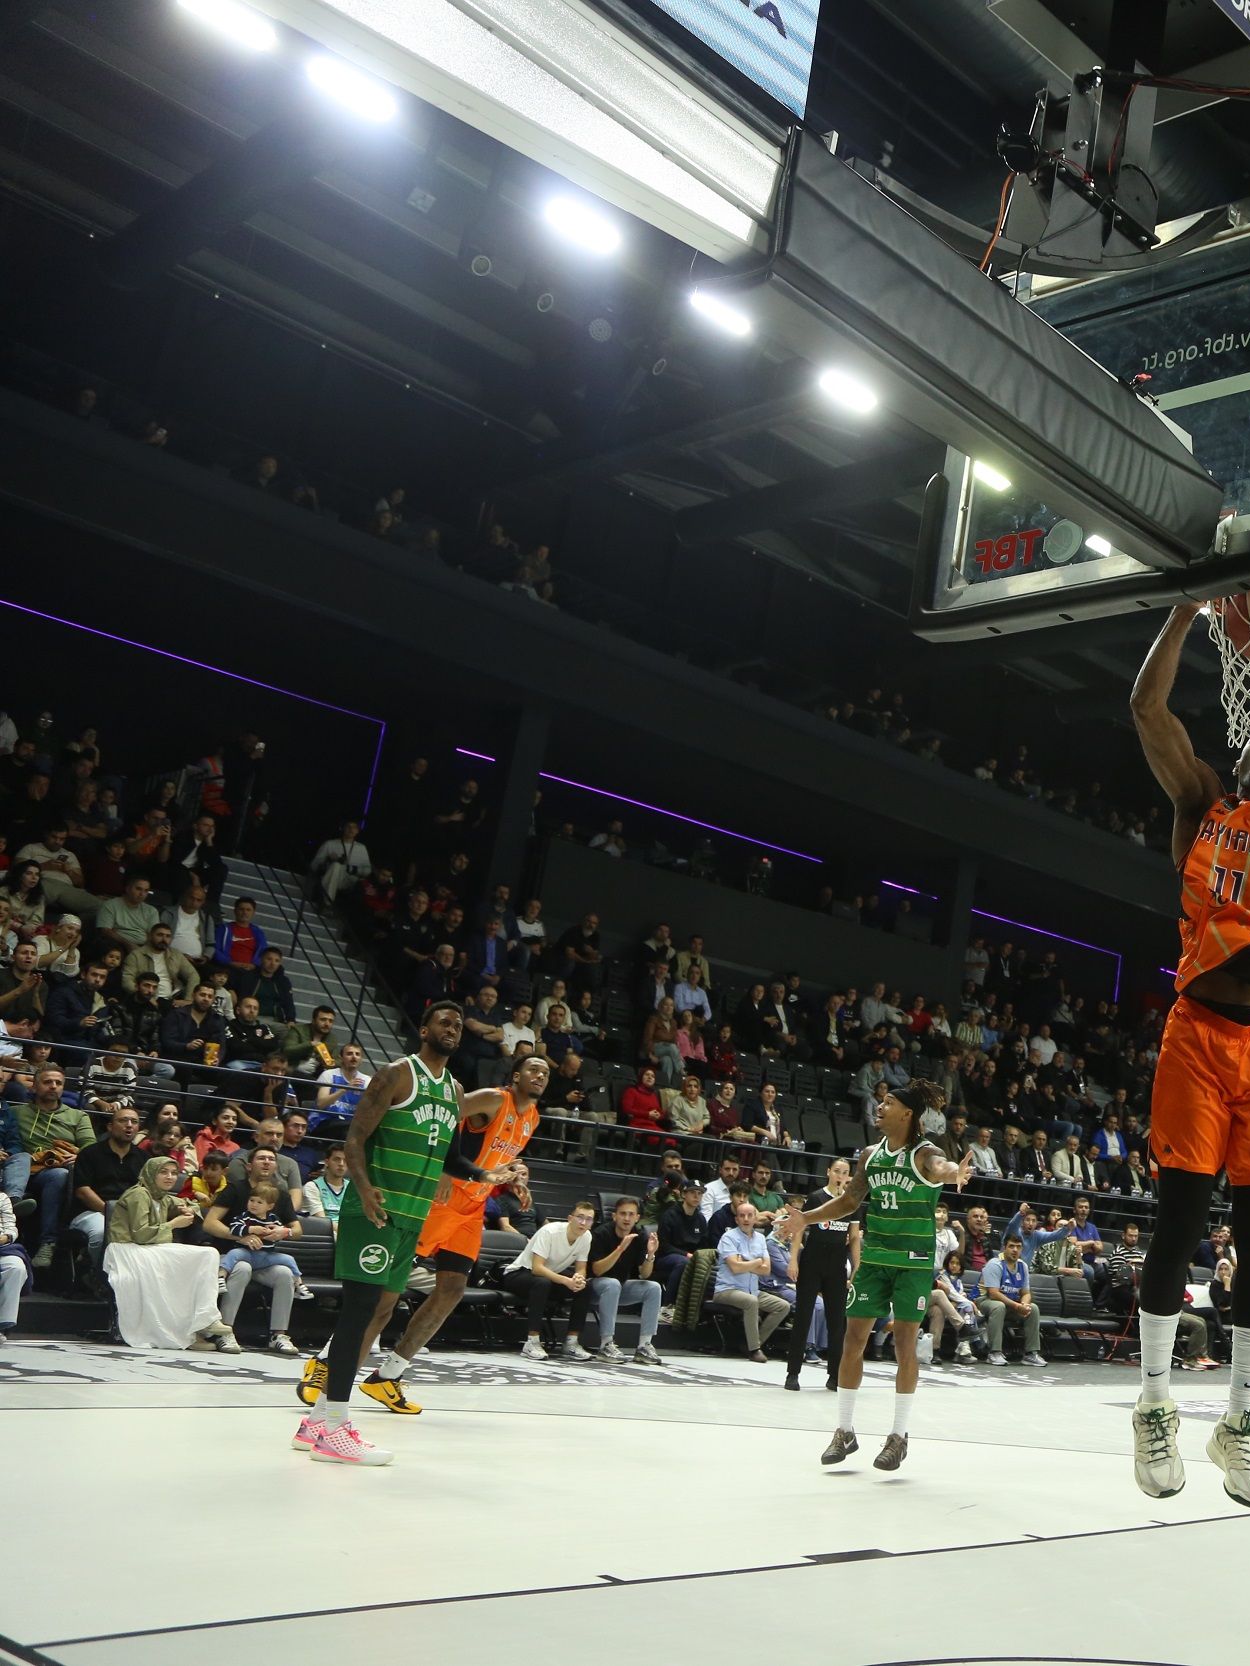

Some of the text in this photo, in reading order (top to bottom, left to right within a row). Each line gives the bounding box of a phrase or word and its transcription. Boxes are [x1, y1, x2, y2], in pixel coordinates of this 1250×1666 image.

[1213, 864, 1245, 905] 11
[428, 1124, 440, 1146] 2
[881, 1190, 898, 1210] 31
